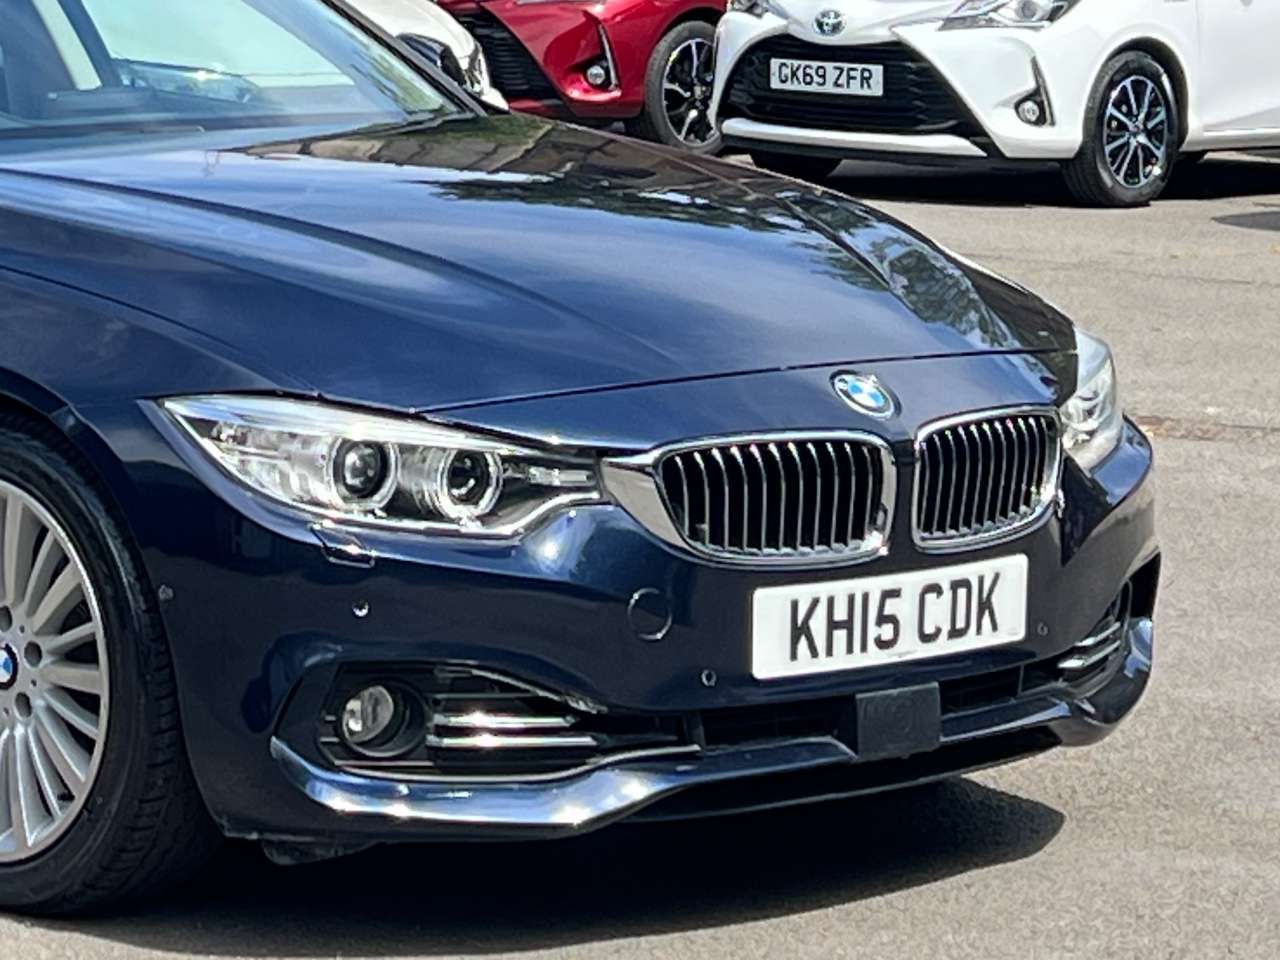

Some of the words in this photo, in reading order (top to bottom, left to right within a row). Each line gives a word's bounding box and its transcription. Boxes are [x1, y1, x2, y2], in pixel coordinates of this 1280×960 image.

[778, 62, 827, 87] GK69
[832, 66, 873, 90] ZFR
[789, 588, 902, 662] KH15
[918, 571, 1001, 644] CDK
